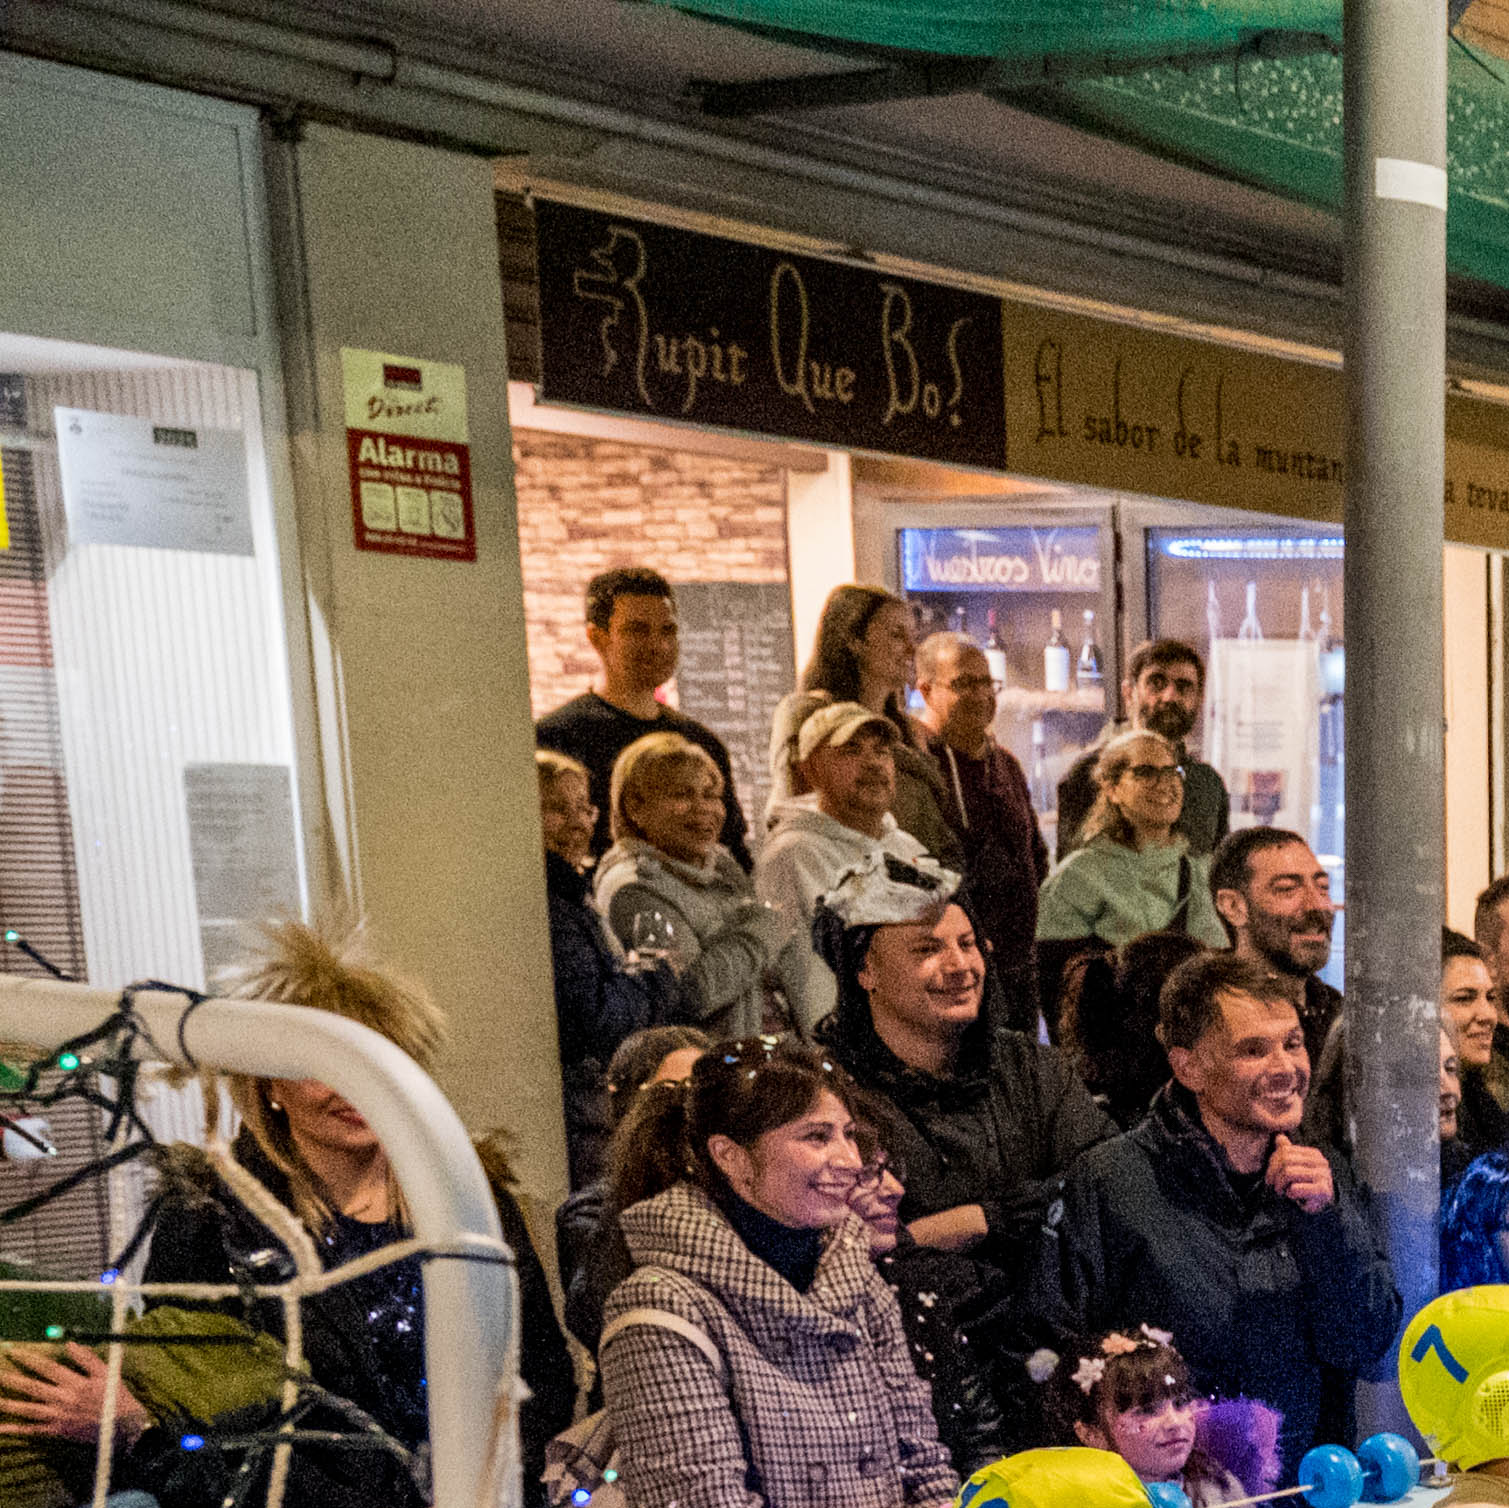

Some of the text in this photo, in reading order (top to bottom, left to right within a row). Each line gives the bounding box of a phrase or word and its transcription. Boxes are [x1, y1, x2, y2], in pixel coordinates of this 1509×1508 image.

[769, 261, 857, 414] Que
[360, 436, 461, 476] Alarma
[1035, 339, 1069, 443] El
[1083, 360, 1160, 451] sabor
[1173, 366, 1201, 459] de
[1215, 374, 1241, 468] la
[1255, 446, 1345, 485] muntan
[1411, 1323, 1470, 1385] 7
